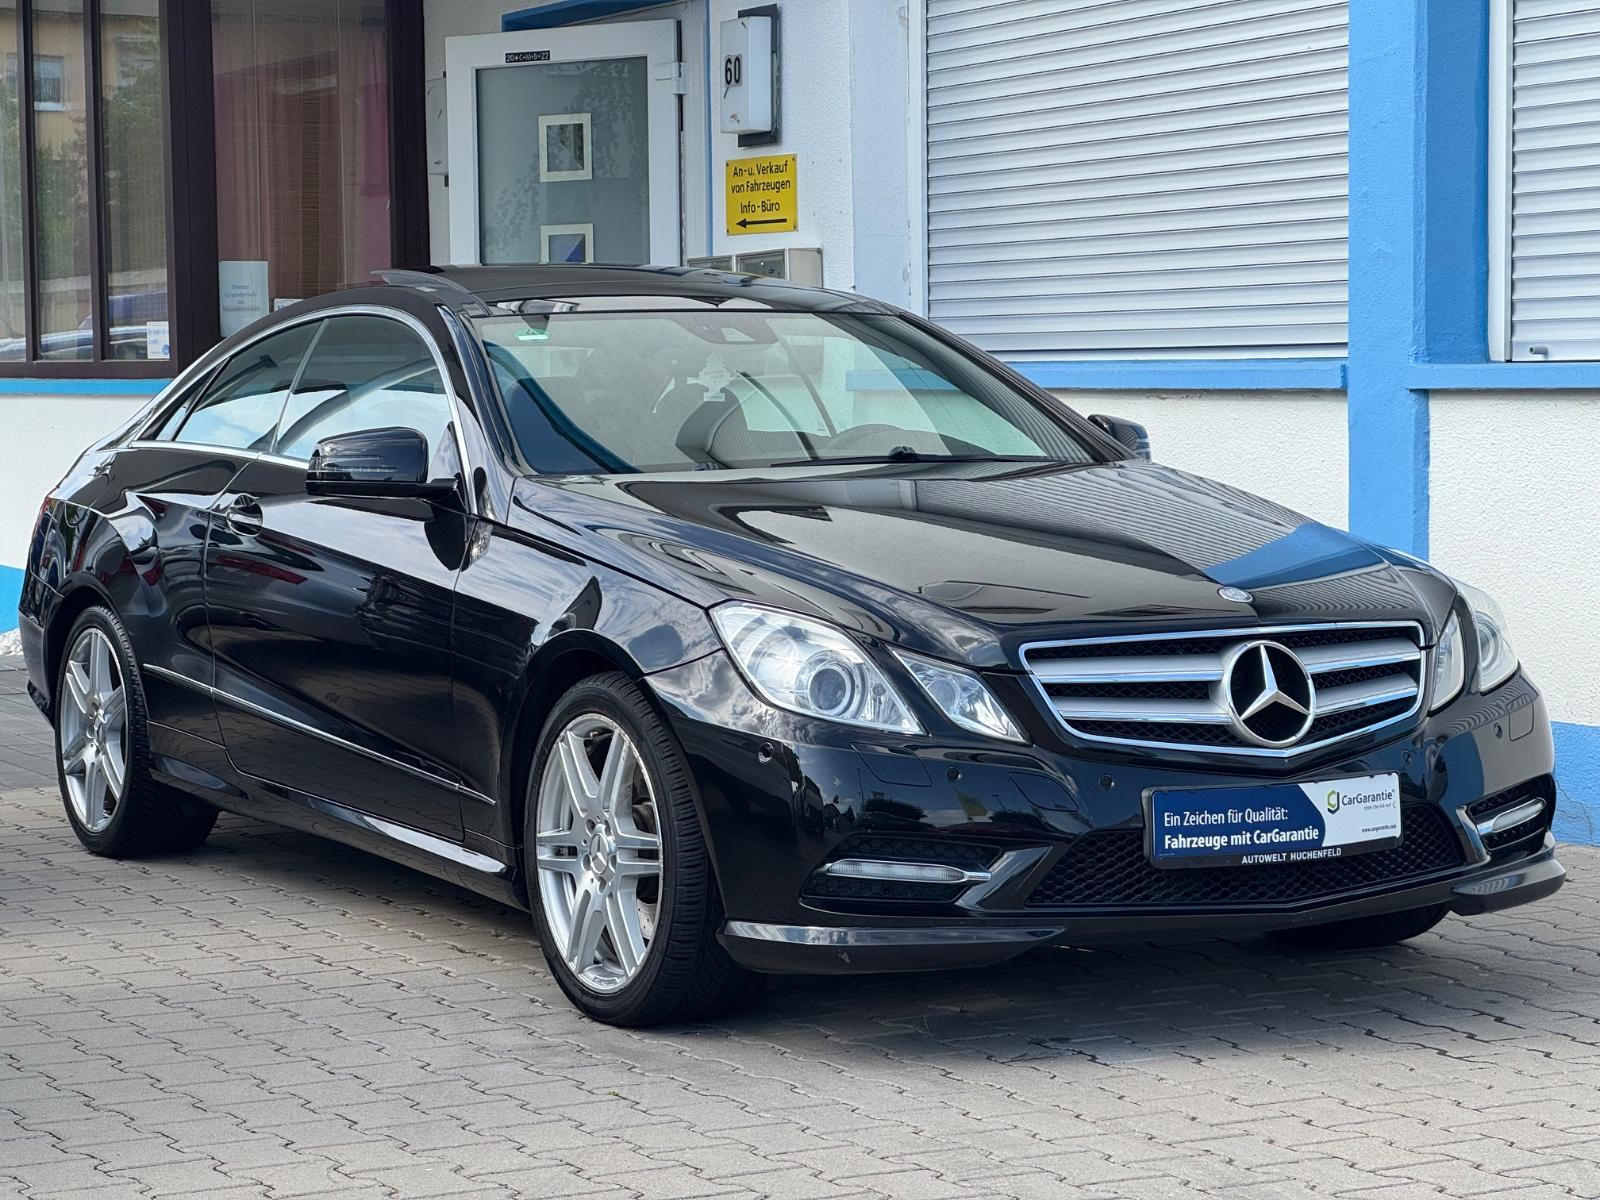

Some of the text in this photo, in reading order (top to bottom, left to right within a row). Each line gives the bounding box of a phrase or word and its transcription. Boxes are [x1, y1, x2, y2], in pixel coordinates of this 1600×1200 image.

[725, 56, 741, 85] 60
[756, 160, 789, 175] Verkauf
[731, 179, 791, 193] von Fahrzeugen
[1341, 790, 1393, 806] CarGarantie
[1164, 806, 1289, 827] Ein Zeichen für Qualität:
[1164, 825, 1319, 850] Fahrzeuge mit CarGarantie
[1241, 847, 1342, 865] AUTOWELT HUCHENFELD
